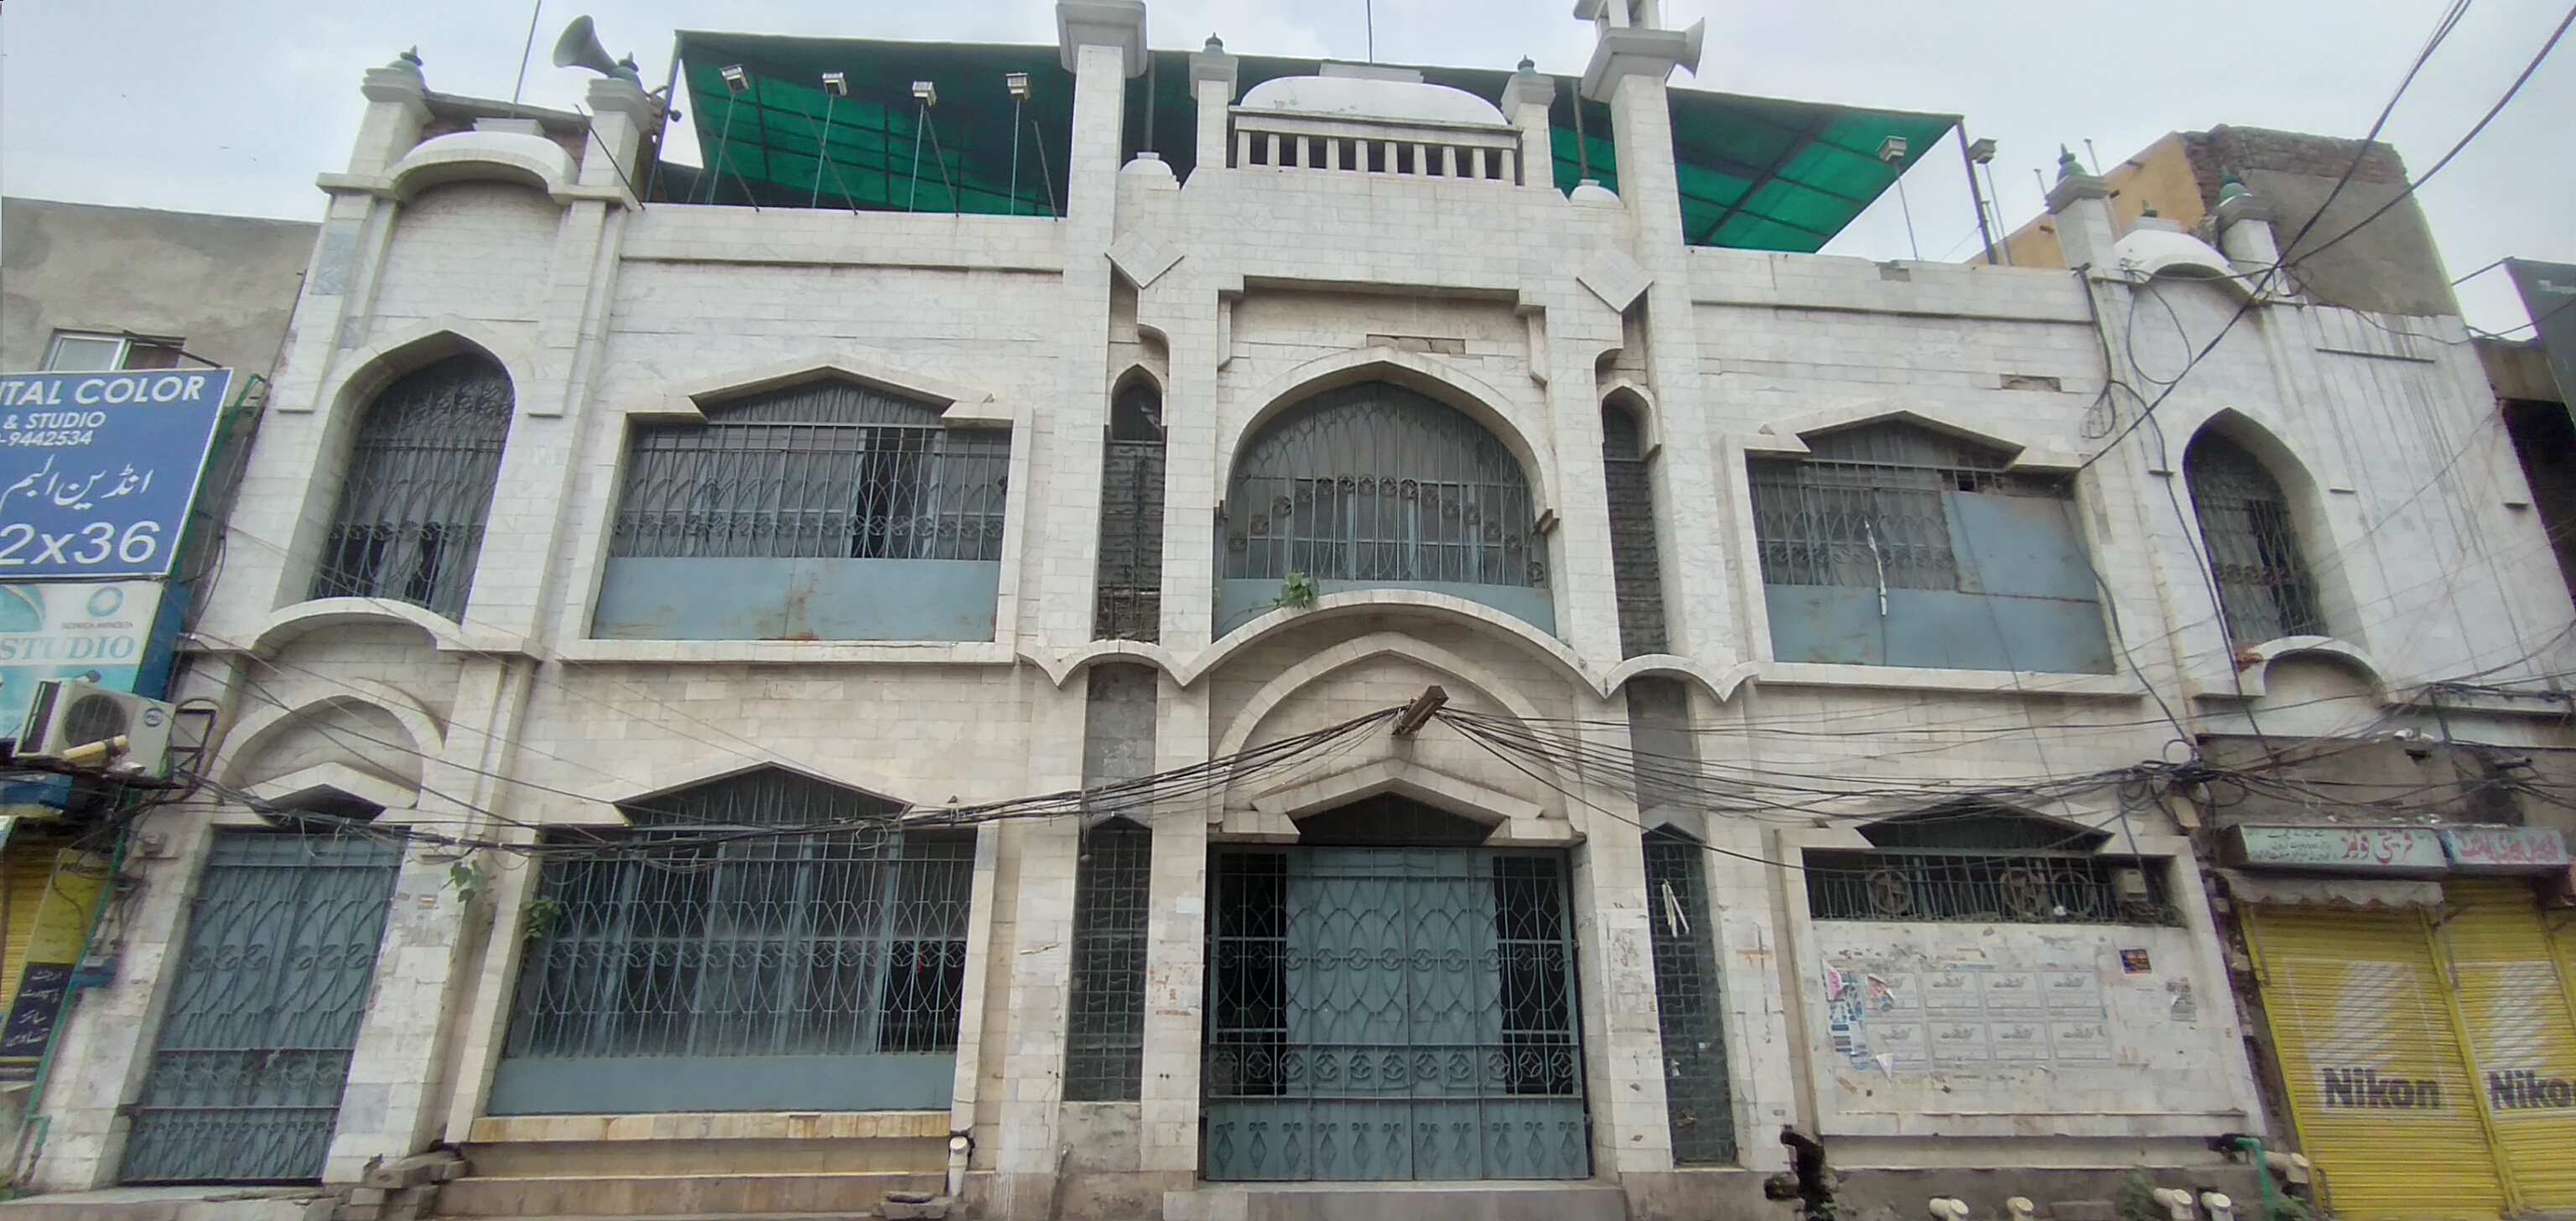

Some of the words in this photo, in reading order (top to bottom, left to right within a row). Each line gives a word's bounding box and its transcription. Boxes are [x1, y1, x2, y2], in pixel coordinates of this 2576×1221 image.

[75, 376, 206, 405] COLOR
[0, 429, 94, 446] -9442534
[3, 414, 18, 430] &
[25, 411, 106, 429] STUDIO
[0, 454, 60, 513] البم
[54, 463, 154, 511] انڈین
[2322, 1068, 2441, 1109] Nikon
[2487, 1070, 2576, 1109] Niko
